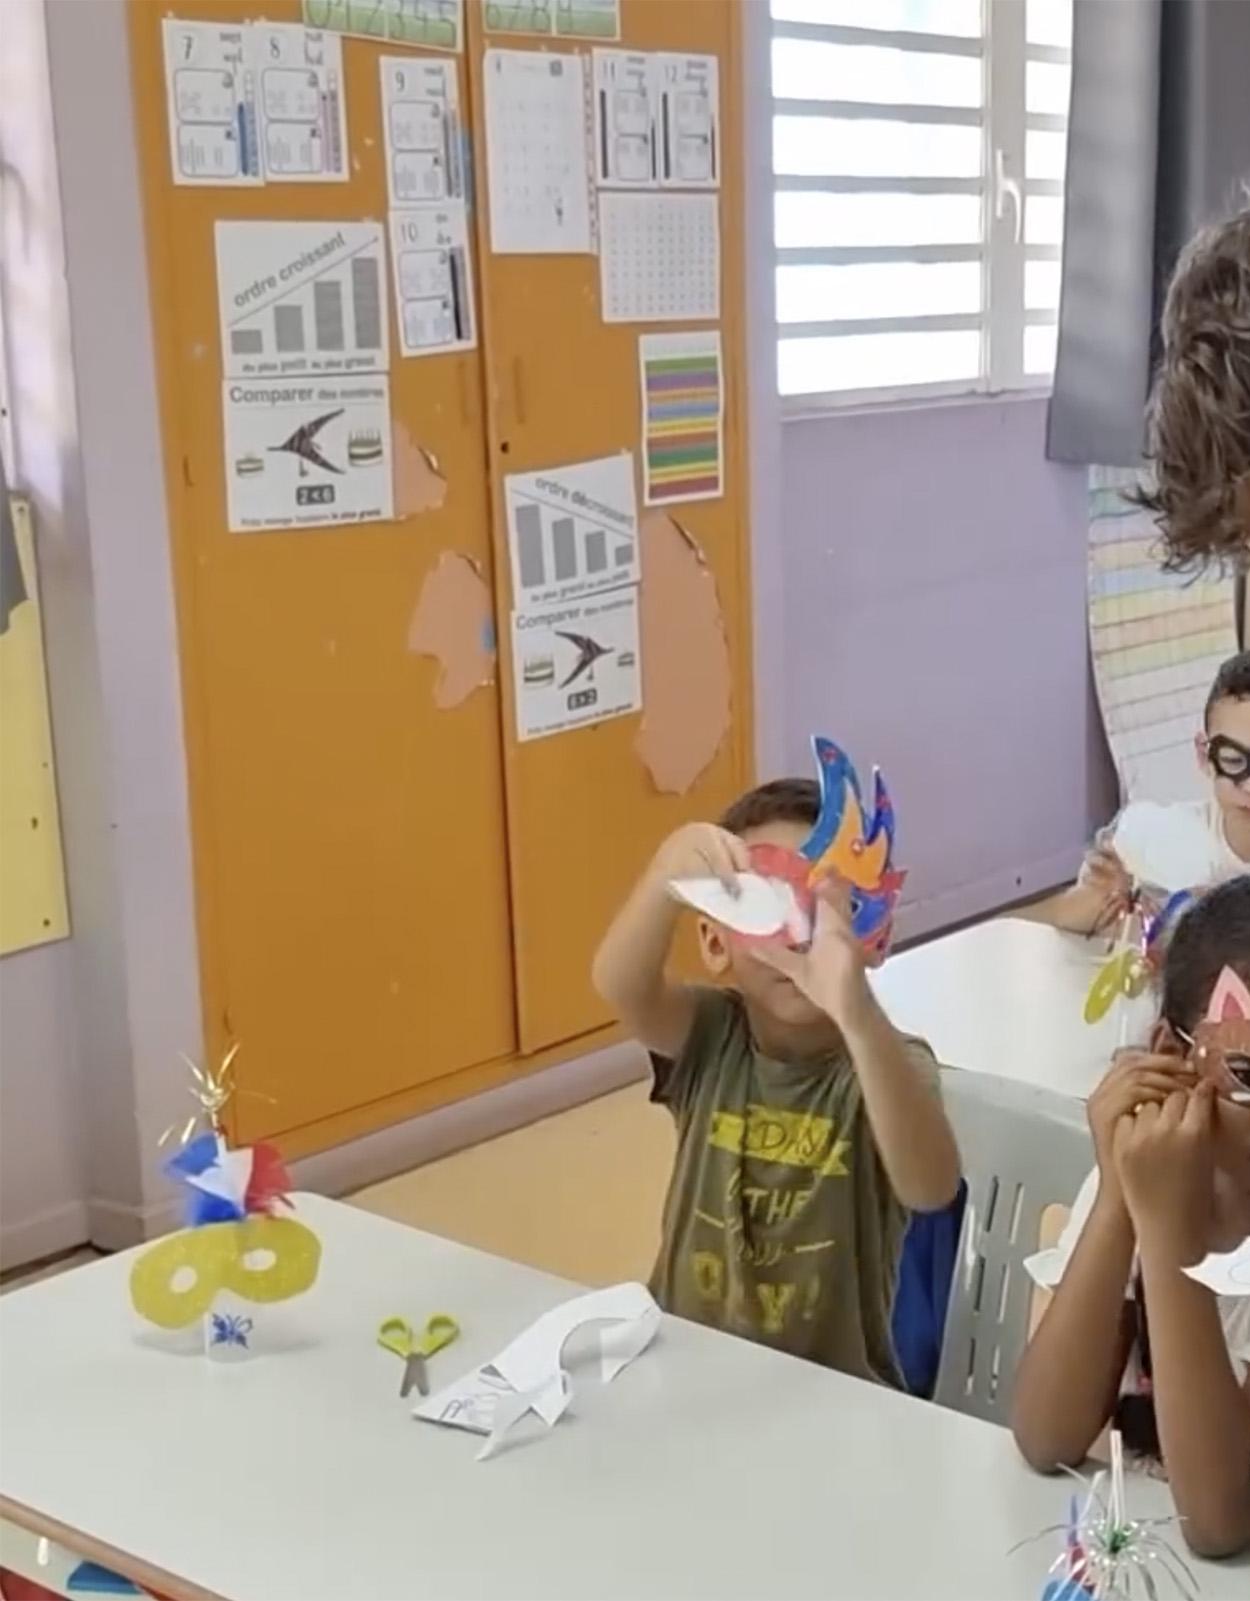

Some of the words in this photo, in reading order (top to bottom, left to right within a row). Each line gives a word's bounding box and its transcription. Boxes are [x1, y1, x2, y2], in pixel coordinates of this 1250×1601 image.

[183, 36, 193, 60] 7
[270, 36, 281, 60] 8
[395, 69, 405, 93] 9
[401, 221, 417, 243] 10
[233, 274, 278, 308] ordre
[279, 231, 346, 282] croissant
[229, 385, 314, 406] Comparer
[516, 607, 581, 630] Comparer
